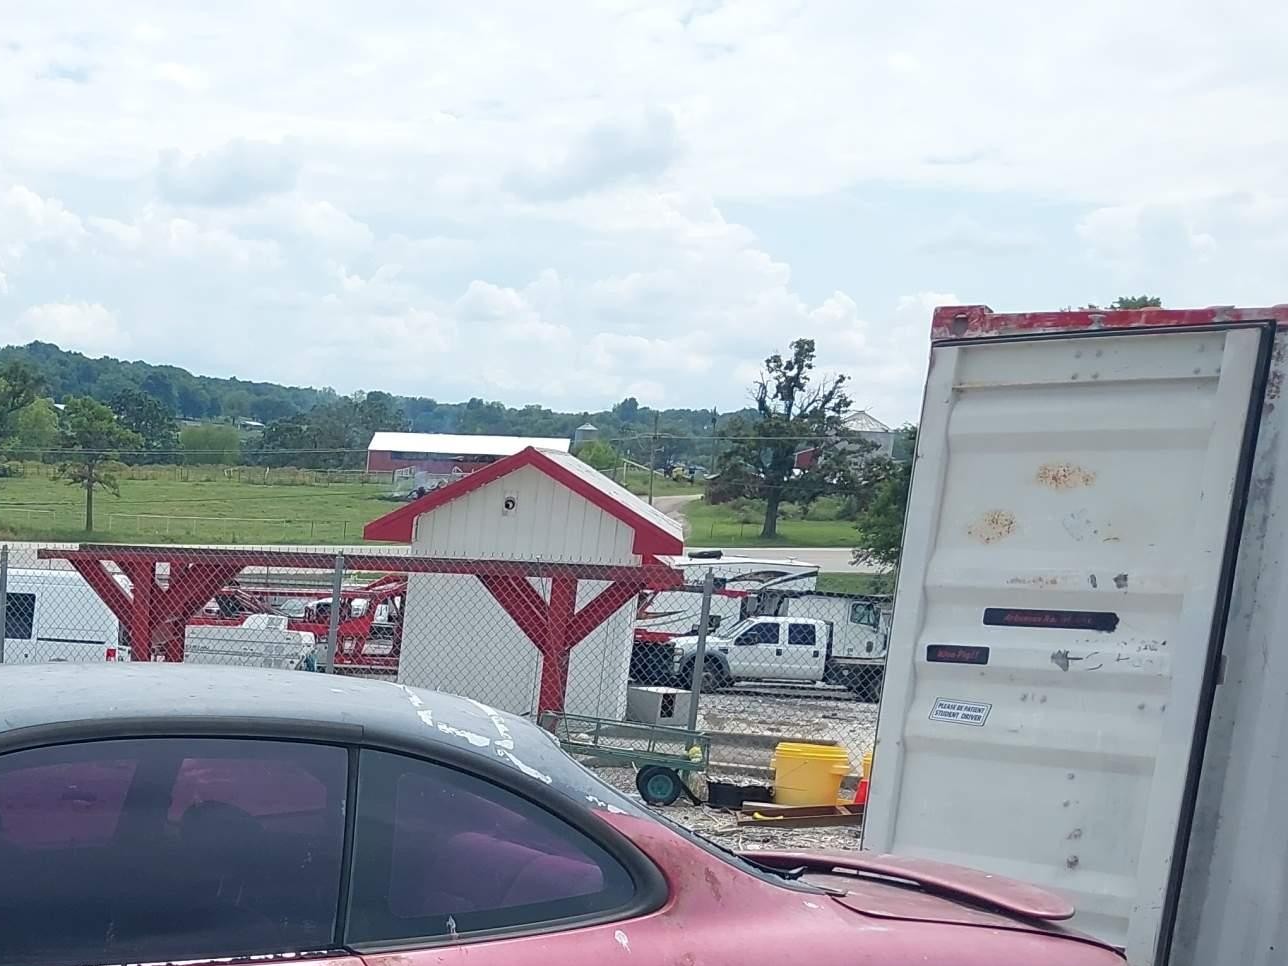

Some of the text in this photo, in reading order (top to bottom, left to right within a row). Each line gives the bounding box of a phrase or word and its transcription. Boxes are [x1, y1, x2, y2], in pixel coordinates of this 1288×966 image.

[937, 702, 957, 711] PLEASE
[963, 705, 985, 714] PATIENT
[934, 709, 982, 721] STUDENT DRIVER
